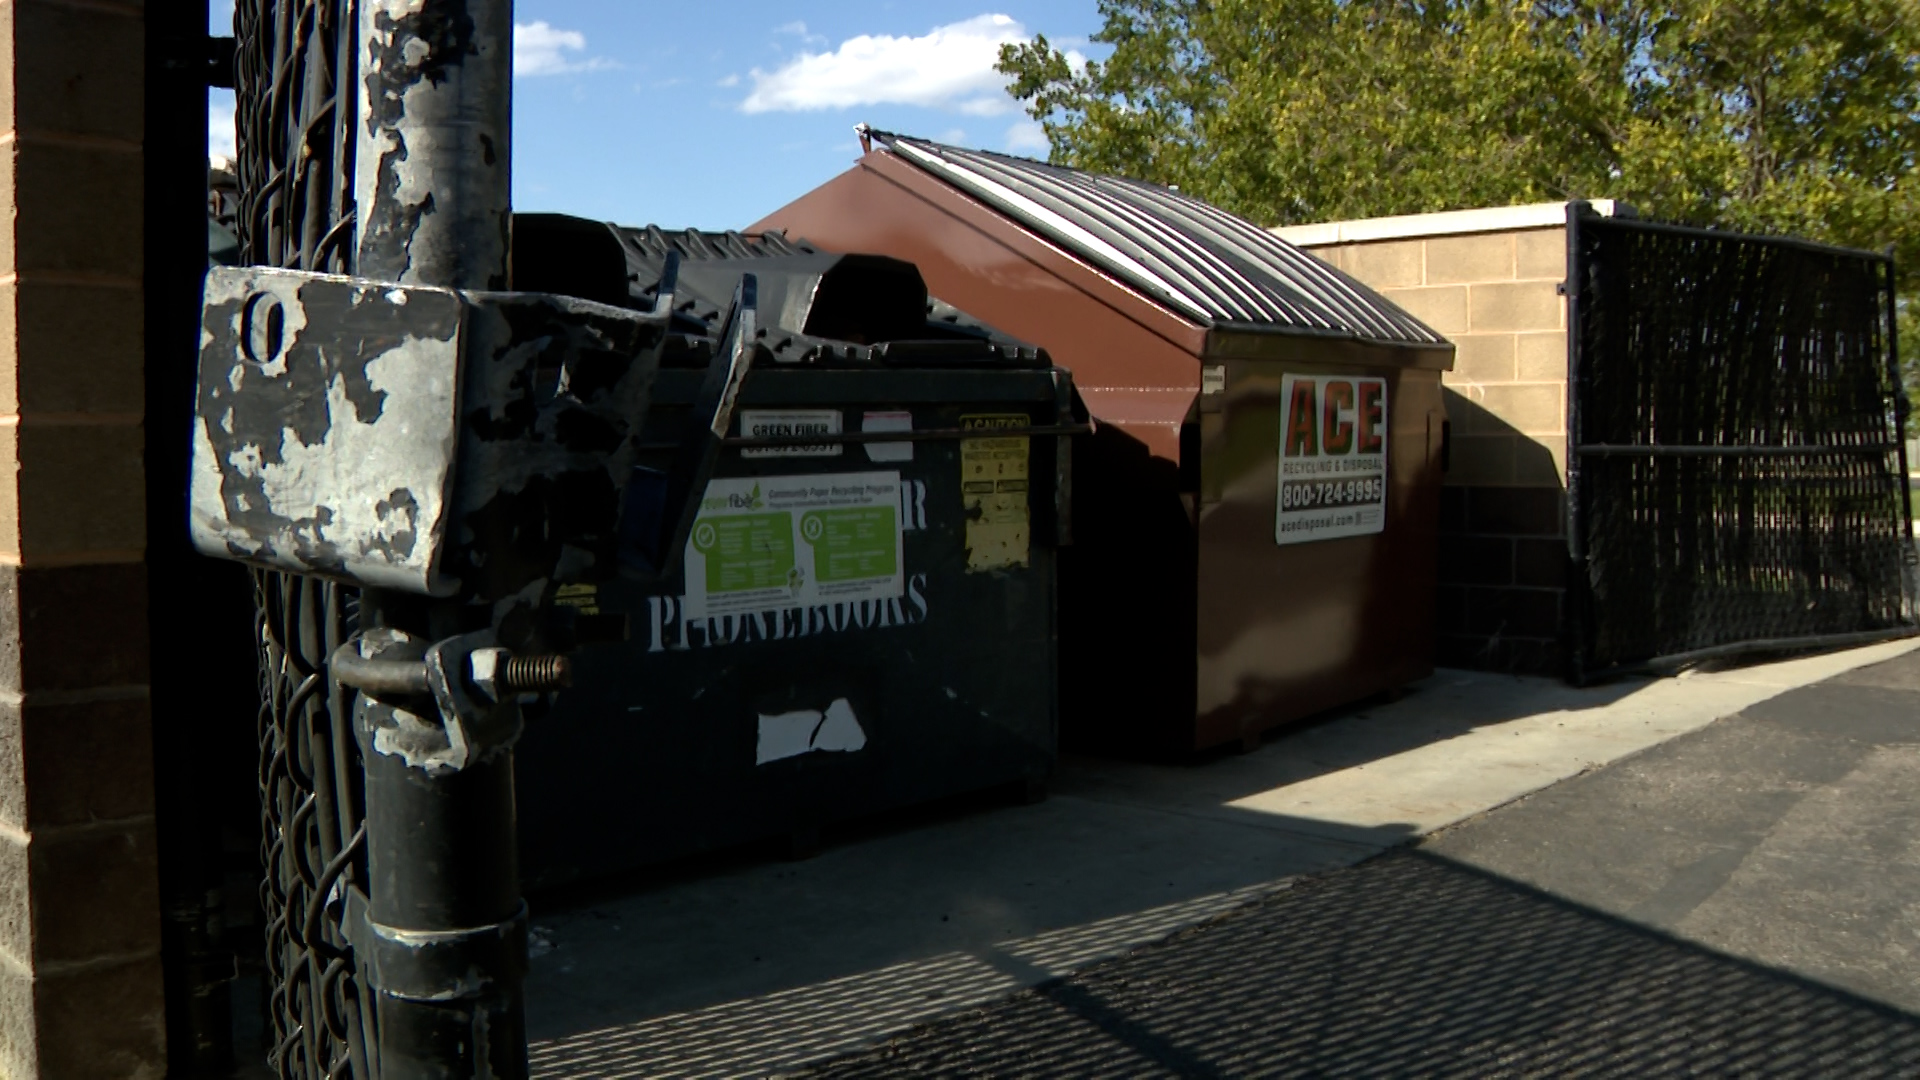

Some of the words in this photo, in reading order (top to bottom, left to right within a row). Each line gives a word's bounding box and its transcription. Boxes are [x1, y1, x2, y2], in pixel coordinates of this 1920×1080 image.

[1284, 380, 1382, 457] ACE
[753, 424, 792, 436] GREEN
[1283, 461, 1333, 474] RECYCLING
[1343, 458, 1383, 472] DISPOSAL
[1283, 479, 1382, 508] 800-724-9995
[1281, 513, 1354, 532] acedisposal.com
